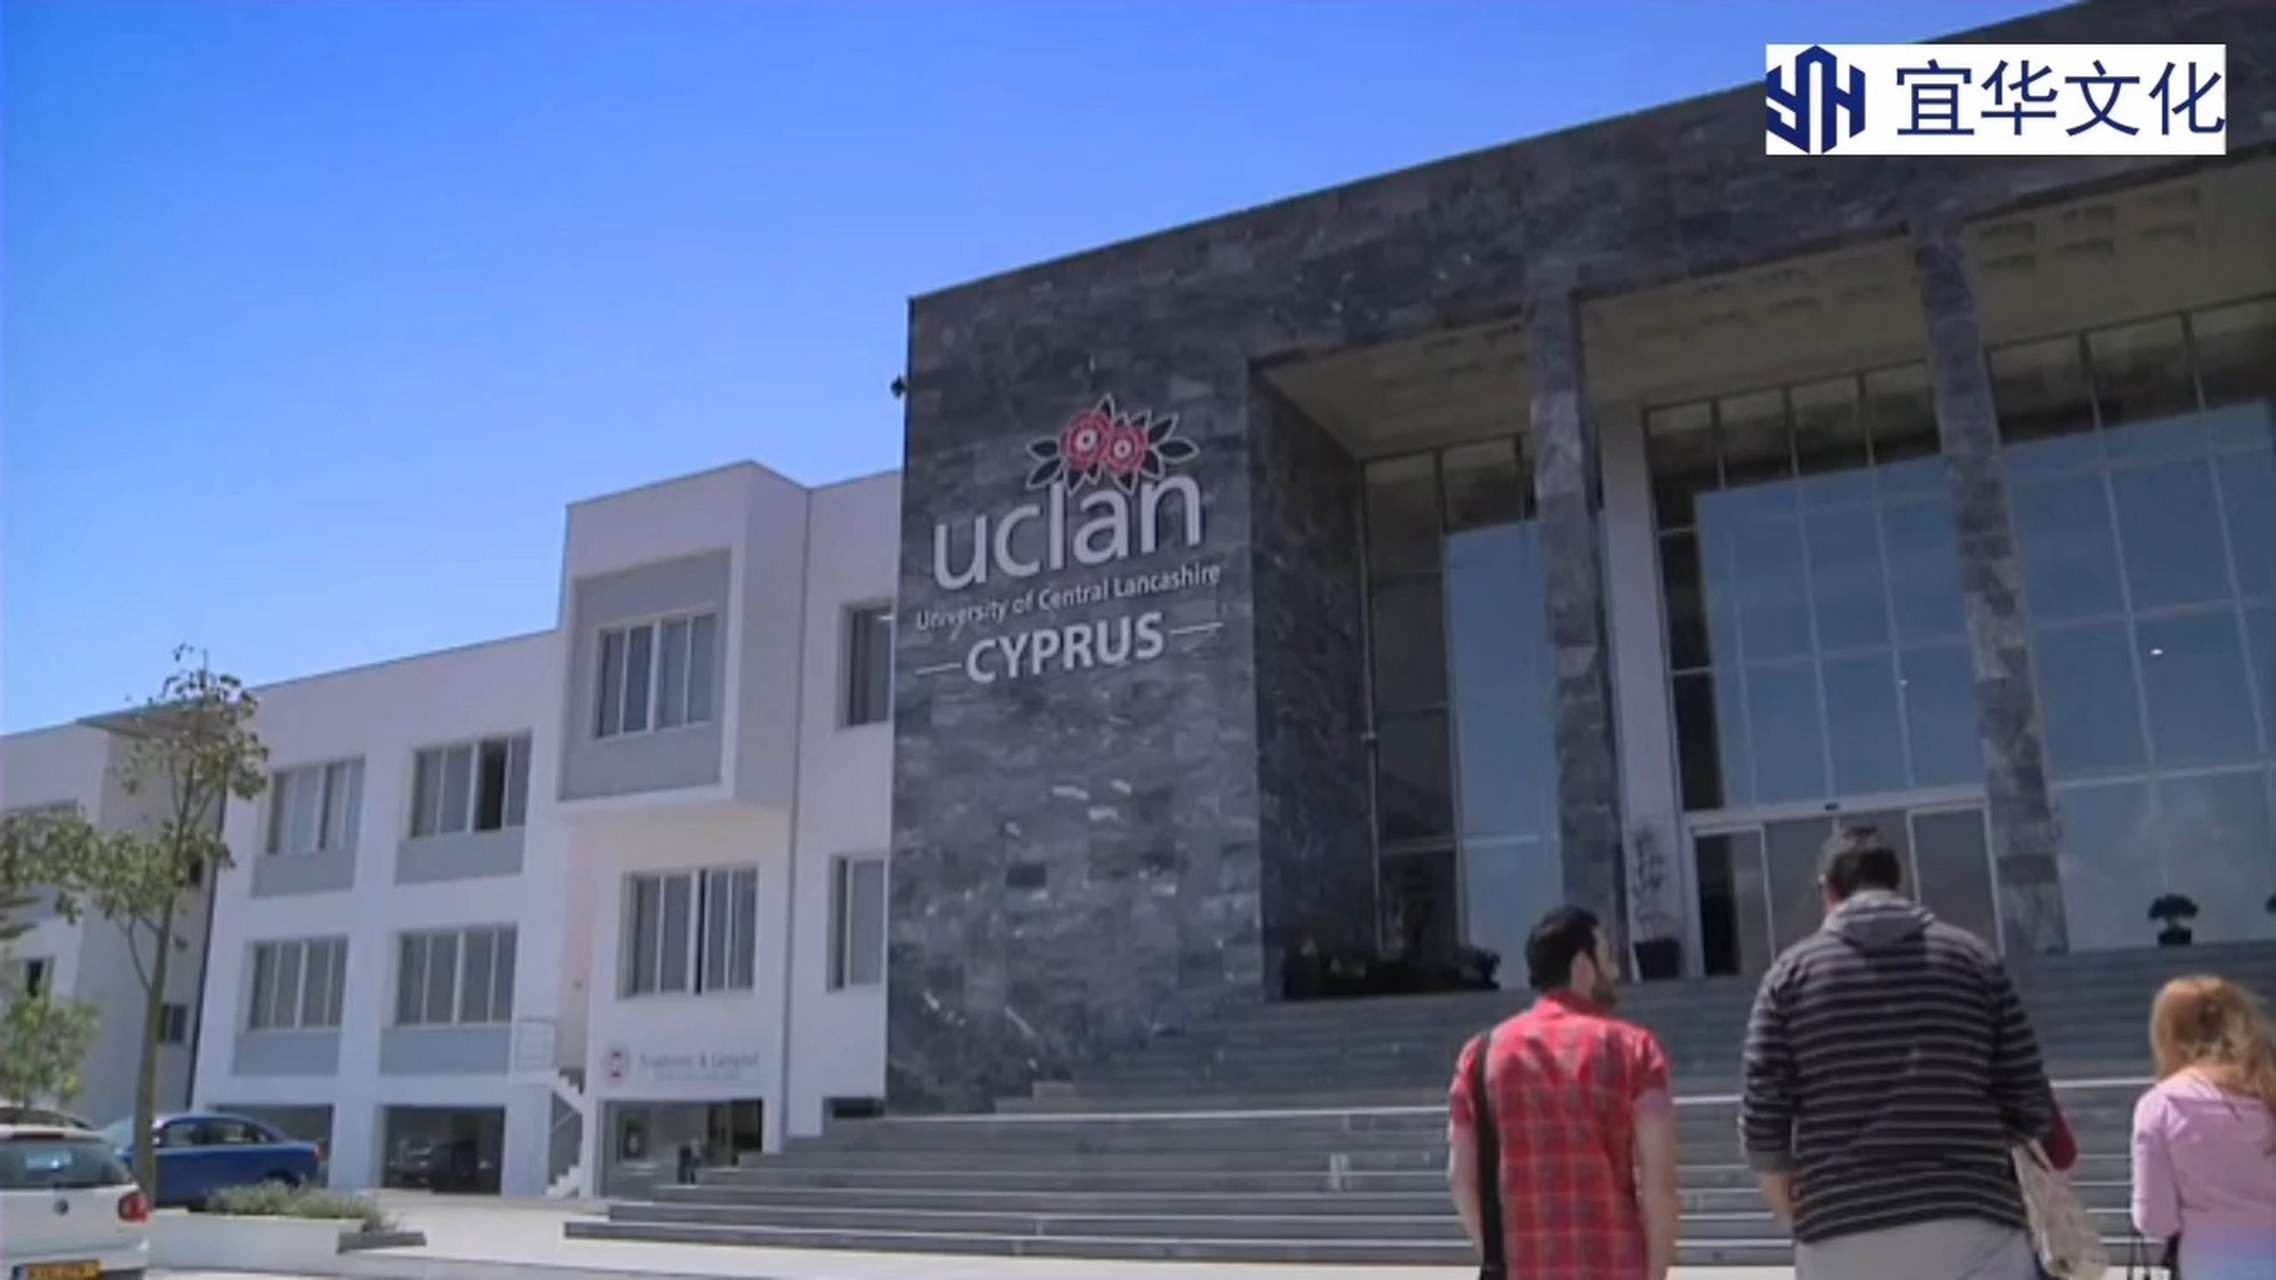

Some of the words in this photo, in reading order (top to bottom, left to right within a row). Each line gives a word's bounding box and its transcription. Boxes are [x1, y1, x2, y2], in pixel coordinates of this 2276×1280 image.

[934, 475, 1201, 591] uclan
[916, 598, 1007, 631] University
[1012, 593, 1035, 614] of
[1038, 577, 1109, 612] Central
[1113, 562, 1222, 599] Lancashire
[965, 611, 1165, 684] CYPRUS
